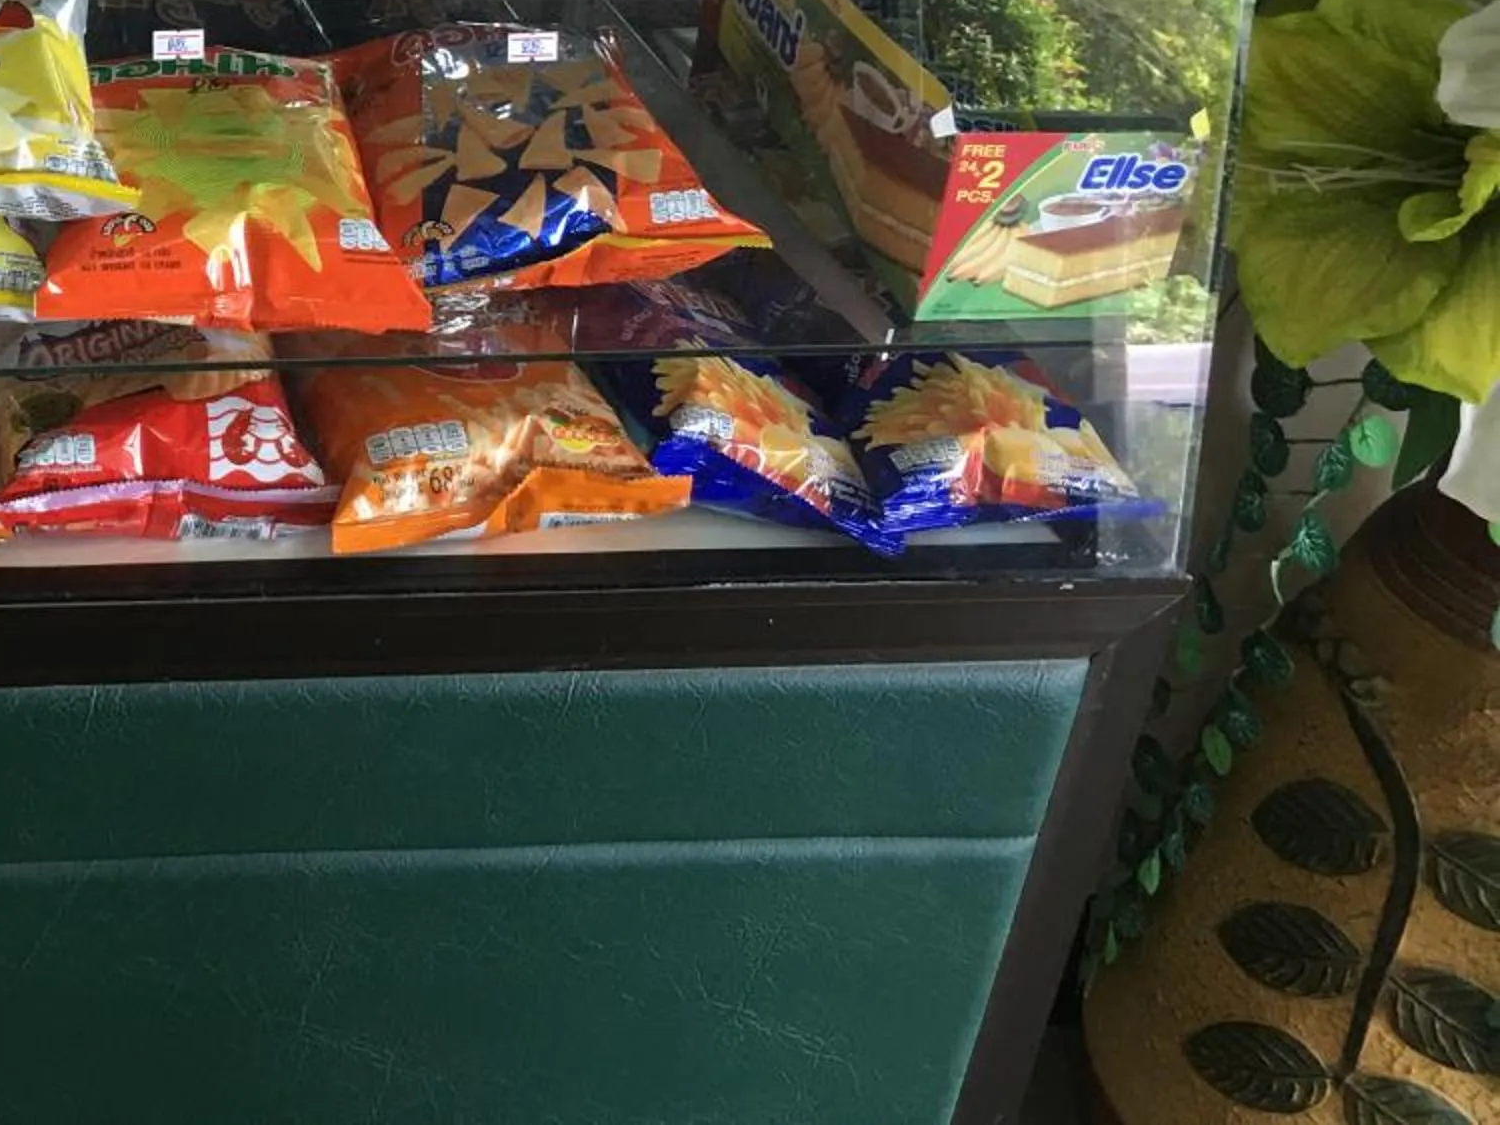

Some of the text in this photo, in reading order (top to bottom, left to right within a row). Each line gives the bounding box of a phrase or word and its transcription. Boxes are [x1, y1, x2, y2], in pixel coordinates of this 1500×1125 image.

[962, 144, 1006, 157] FREE
[1079, 154, 1187, 190] Ellse
[956, 189, 996, 203] PCS.
